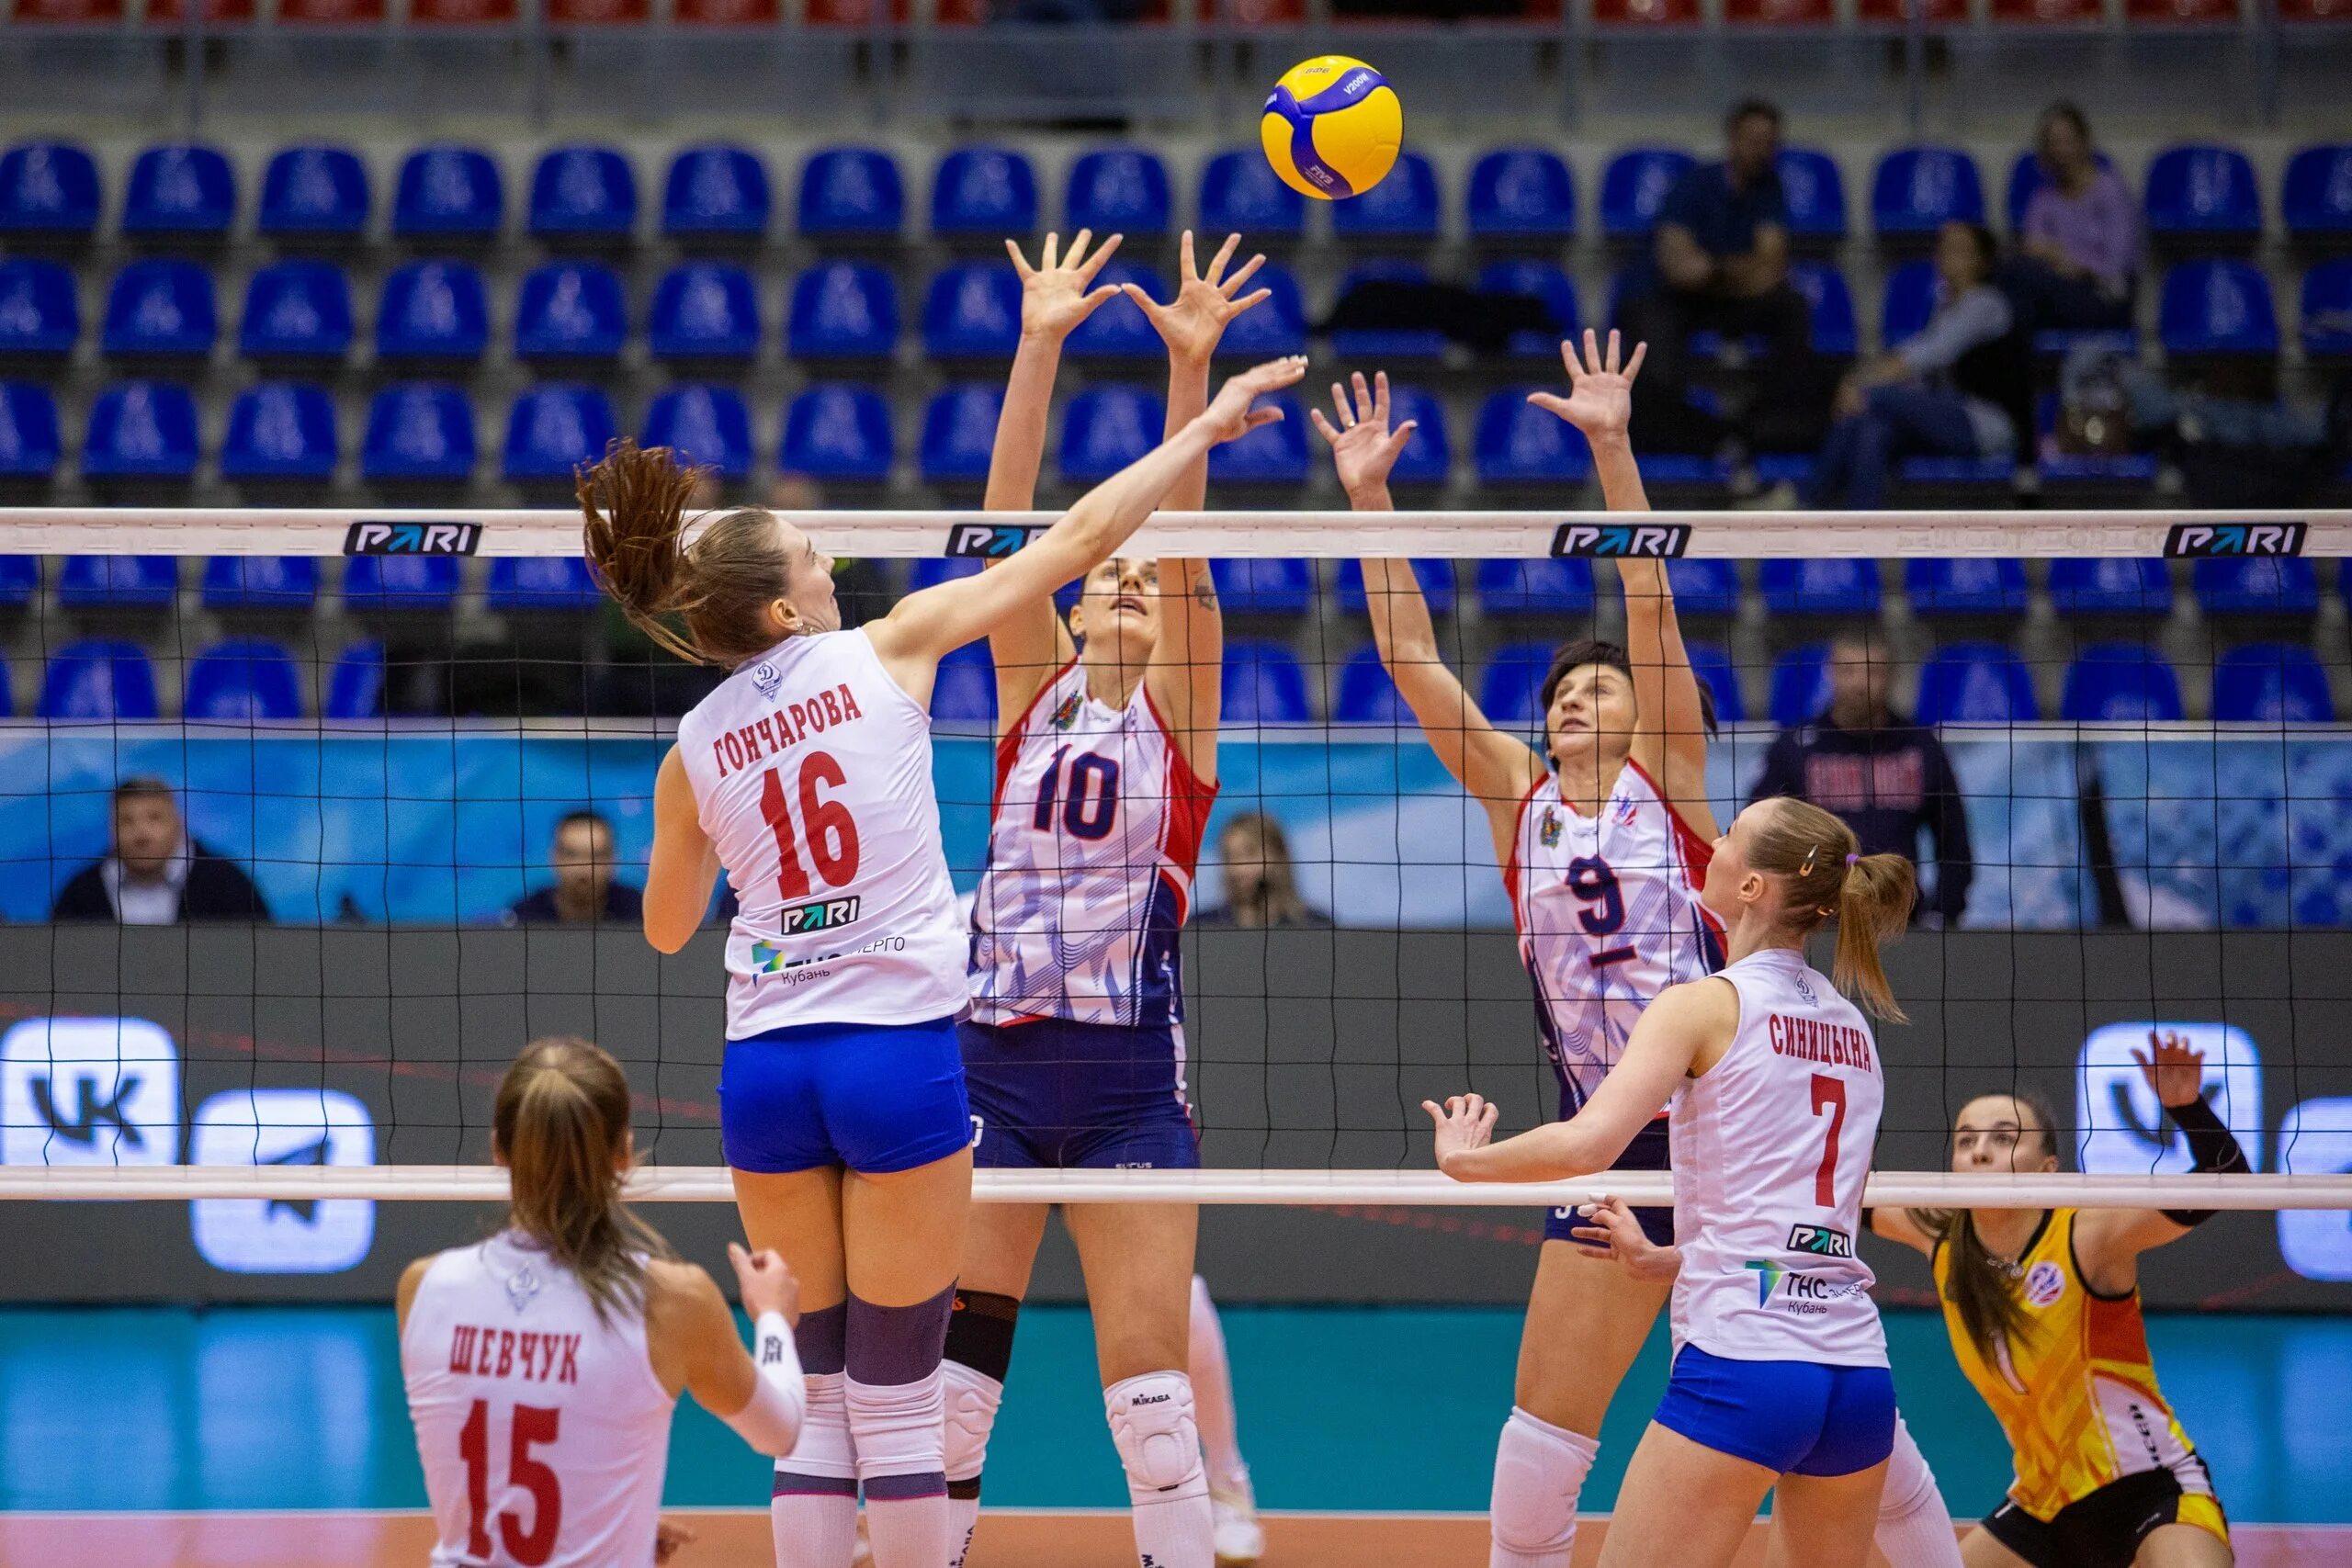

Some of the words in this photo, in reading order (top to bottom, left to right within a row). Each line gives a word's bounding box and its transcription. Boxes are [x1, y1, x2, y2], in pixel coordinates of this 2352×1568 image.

[1343, 73, 1369, 96] V200W
[355, 525, 471, 552] PARI
[956, 527, 1049, 554] PA
[1562, 527, 1679, 555] PARI
[2177, 525, 2296, 554] PARI
[713, 682, 862, 778] ГОНЧАРОВА
[1033, 743, 1120, 840] 10
[760, 750, 860, 899] 16
[1566, 854, 1625, 936] 9
[784, 899, 857, 934] PARI
[781, 969, 831, 986] Кубань
[1769, 1013, 1871, 1073] СИНИЦЫНА
[30, 1076, 144, 1146] VK
[1811, 1073, 1846, 1208] 7
[1789, 1227, 1849, 1256] PARI
[1788, 1272, 1827, 1299] ТНС
[1788, 1301, 1827, 1315] Кубань
[449, 1324, 582, 1385] ШЕВЧУК
[459, 1399, 562, 1567] 15
